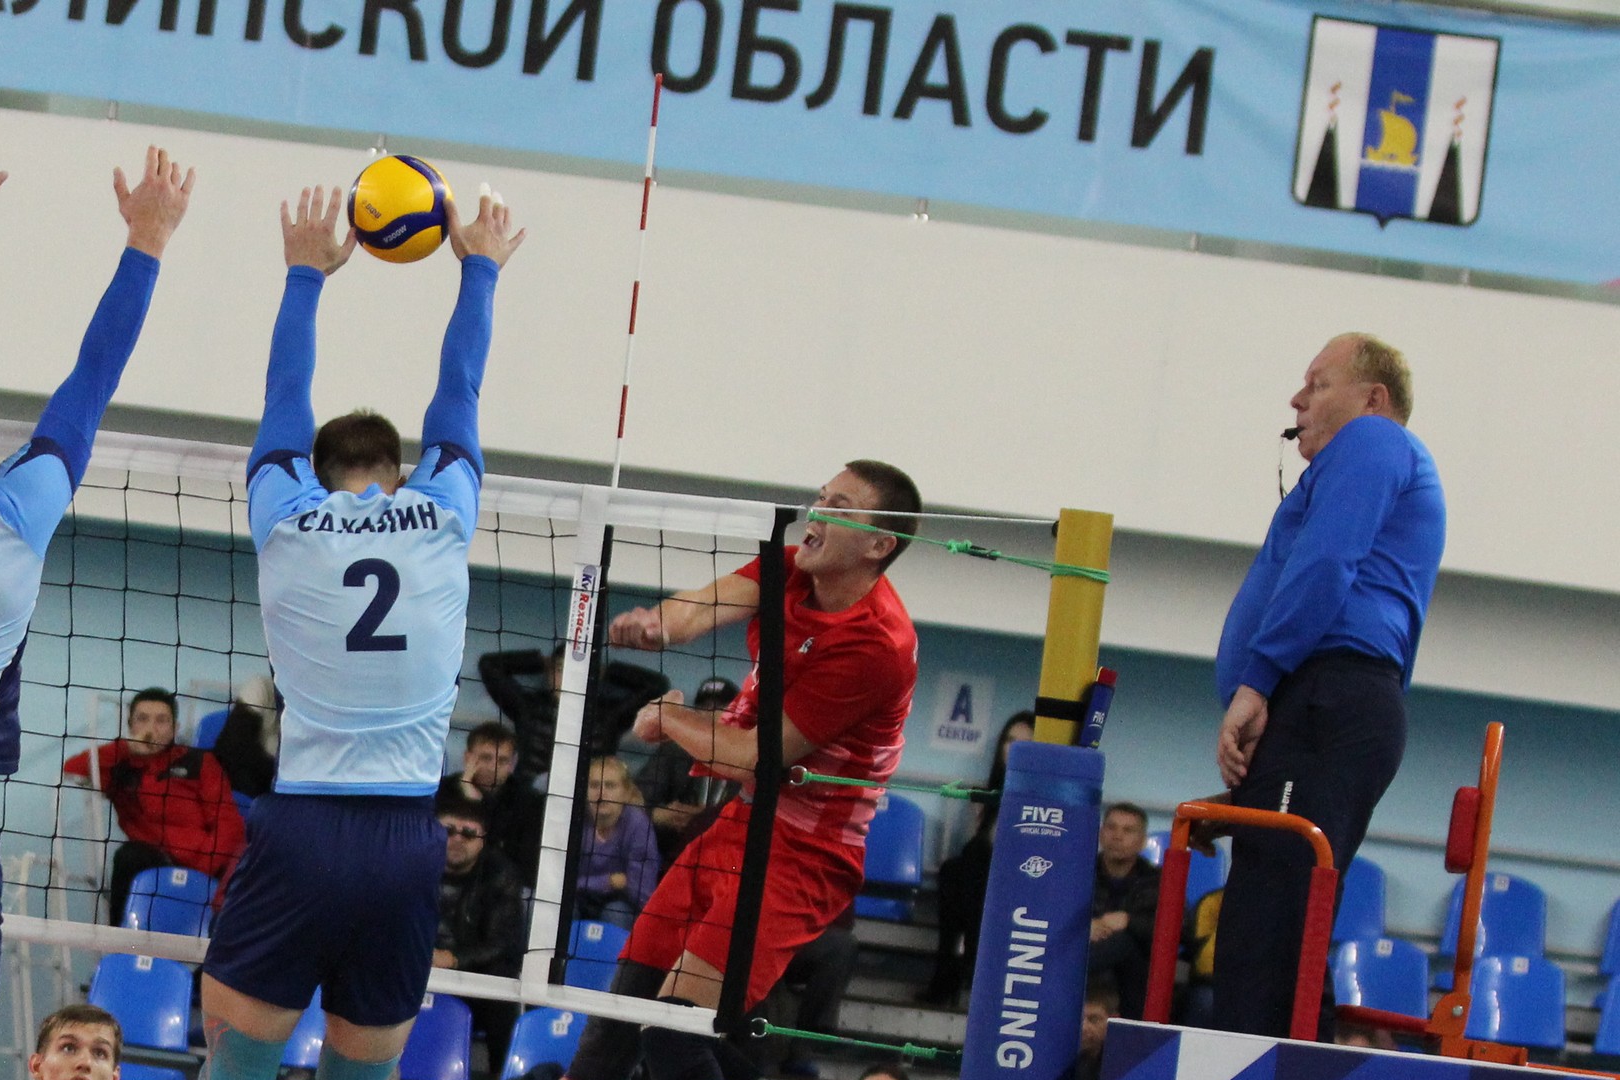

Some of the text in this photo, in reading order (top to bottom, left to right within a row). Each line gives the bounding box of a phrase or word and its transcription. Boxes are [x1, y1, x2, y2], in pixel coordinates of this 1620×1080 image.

[649, 0, 1215, 156] ОБЛАСТИ
[343, 557, 408, 652] 2
[1021, 805, 1064, 824] FIVB
[996, 906, 1049, 1069] JINLING
